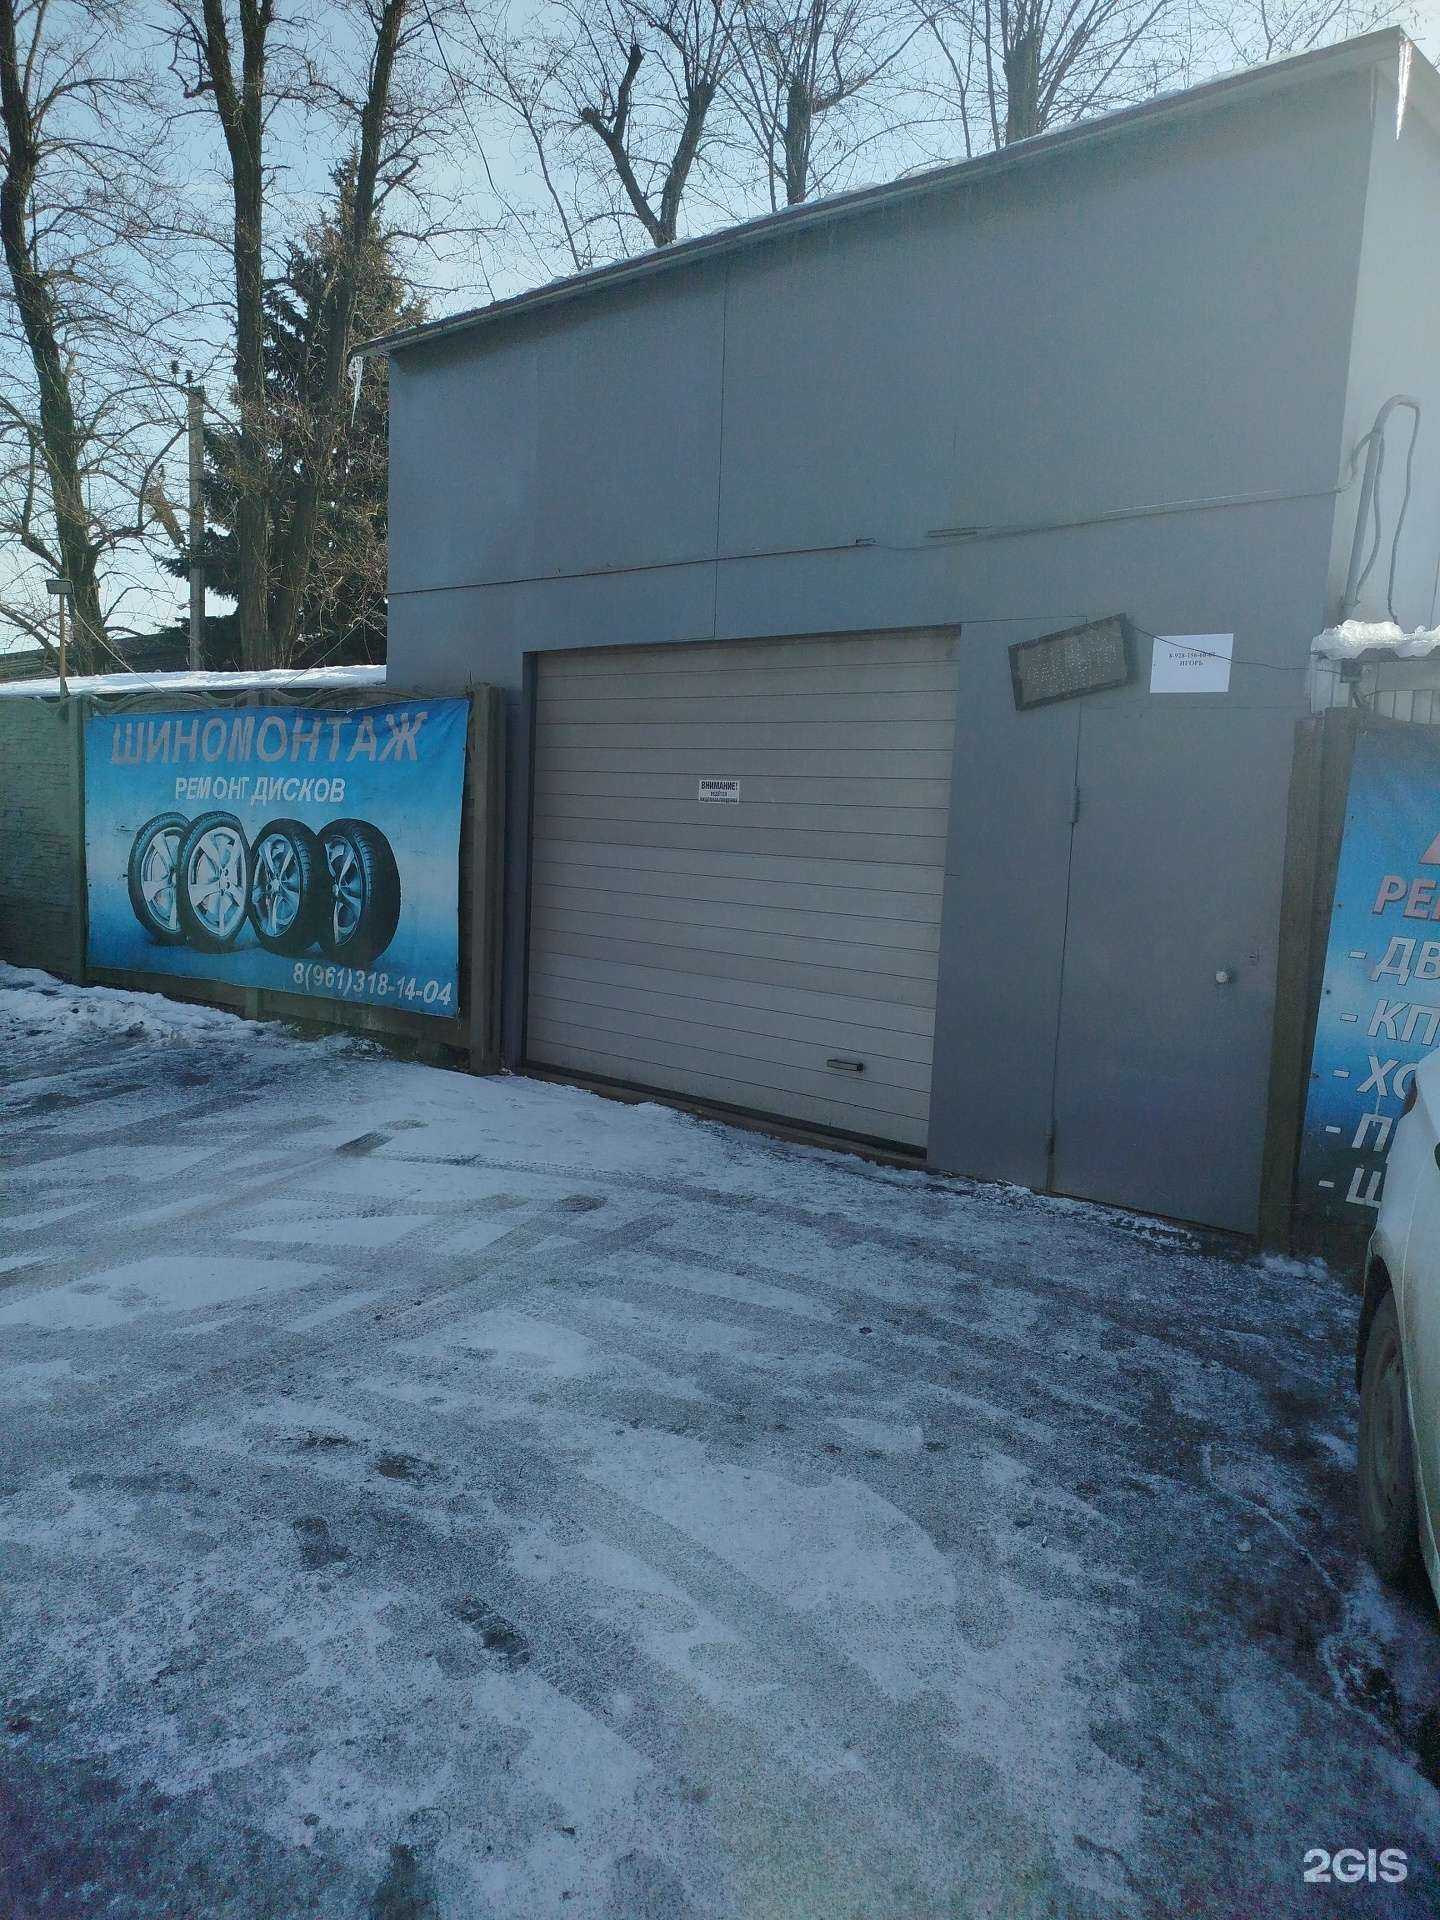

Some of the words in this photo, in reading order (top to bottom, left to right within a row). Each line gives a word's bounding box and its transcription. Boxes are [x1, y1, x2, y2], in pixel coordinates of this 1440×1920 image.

[110, 711, 428, 764] ШИНОМОНТАЖ
[175, 776, 250, 800] РЕМОНТ
[250, 777, 346, 806] ДИСКОВ
[701, 781, 738, 791] ВНИМАНИЕ!
[1372, 875, 1440, 921] РЕ
[293, 962, 452, 1006] 8(961)318-14-04
